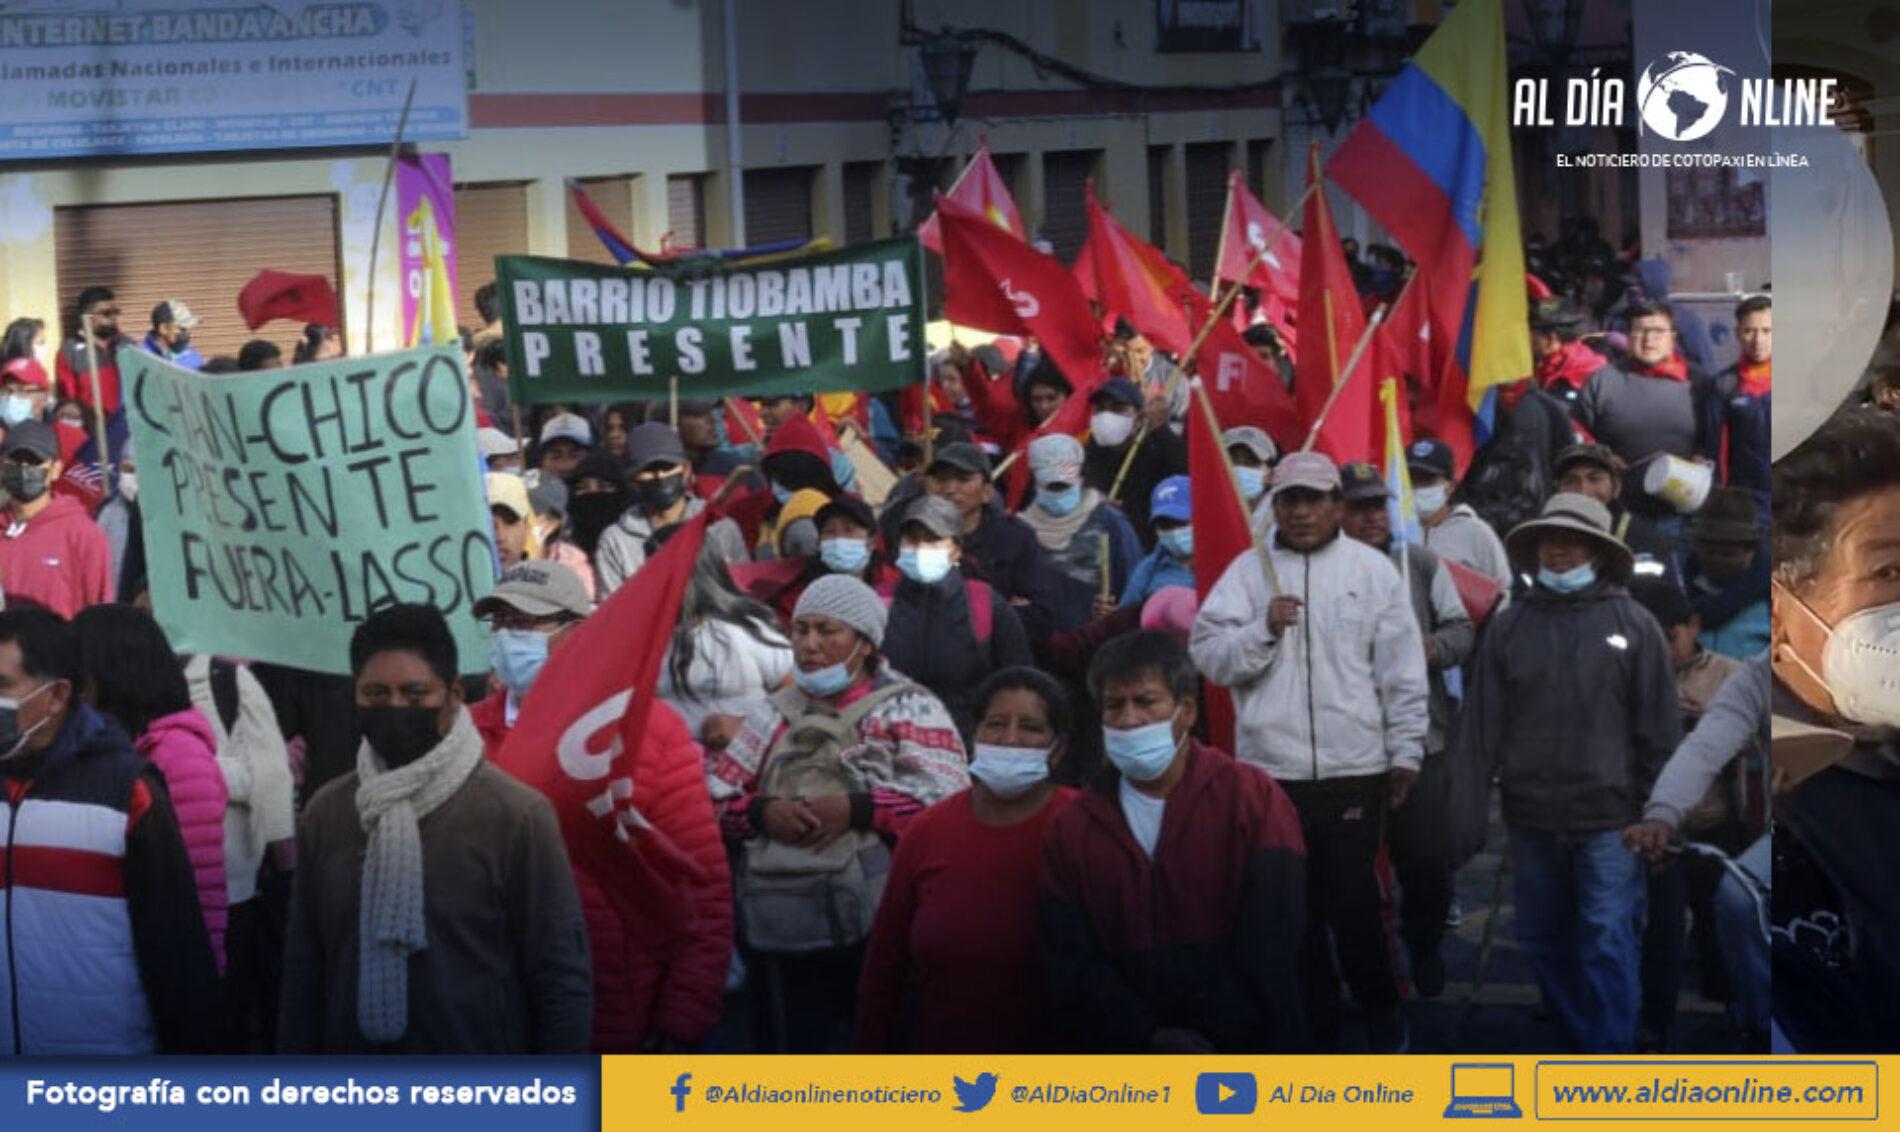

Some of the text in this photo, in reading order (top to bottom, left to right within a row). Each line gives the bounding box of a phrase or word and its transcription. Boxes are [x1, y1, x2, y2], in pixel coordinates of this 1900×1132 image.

[153, 9, 260, 41] BANDA
[268, 7, 377, 38] ANCHA
[110, 57, 242, 77] Nacionales
[250, 59, 262, 72] e
[269, 50, 451, 72] Internacionales
[351, 78, 398, 97] CNT
[513, 260, 912, 325] BARRIO TIOBAMBA
[522, 314, 911, 378] PRESENTE
